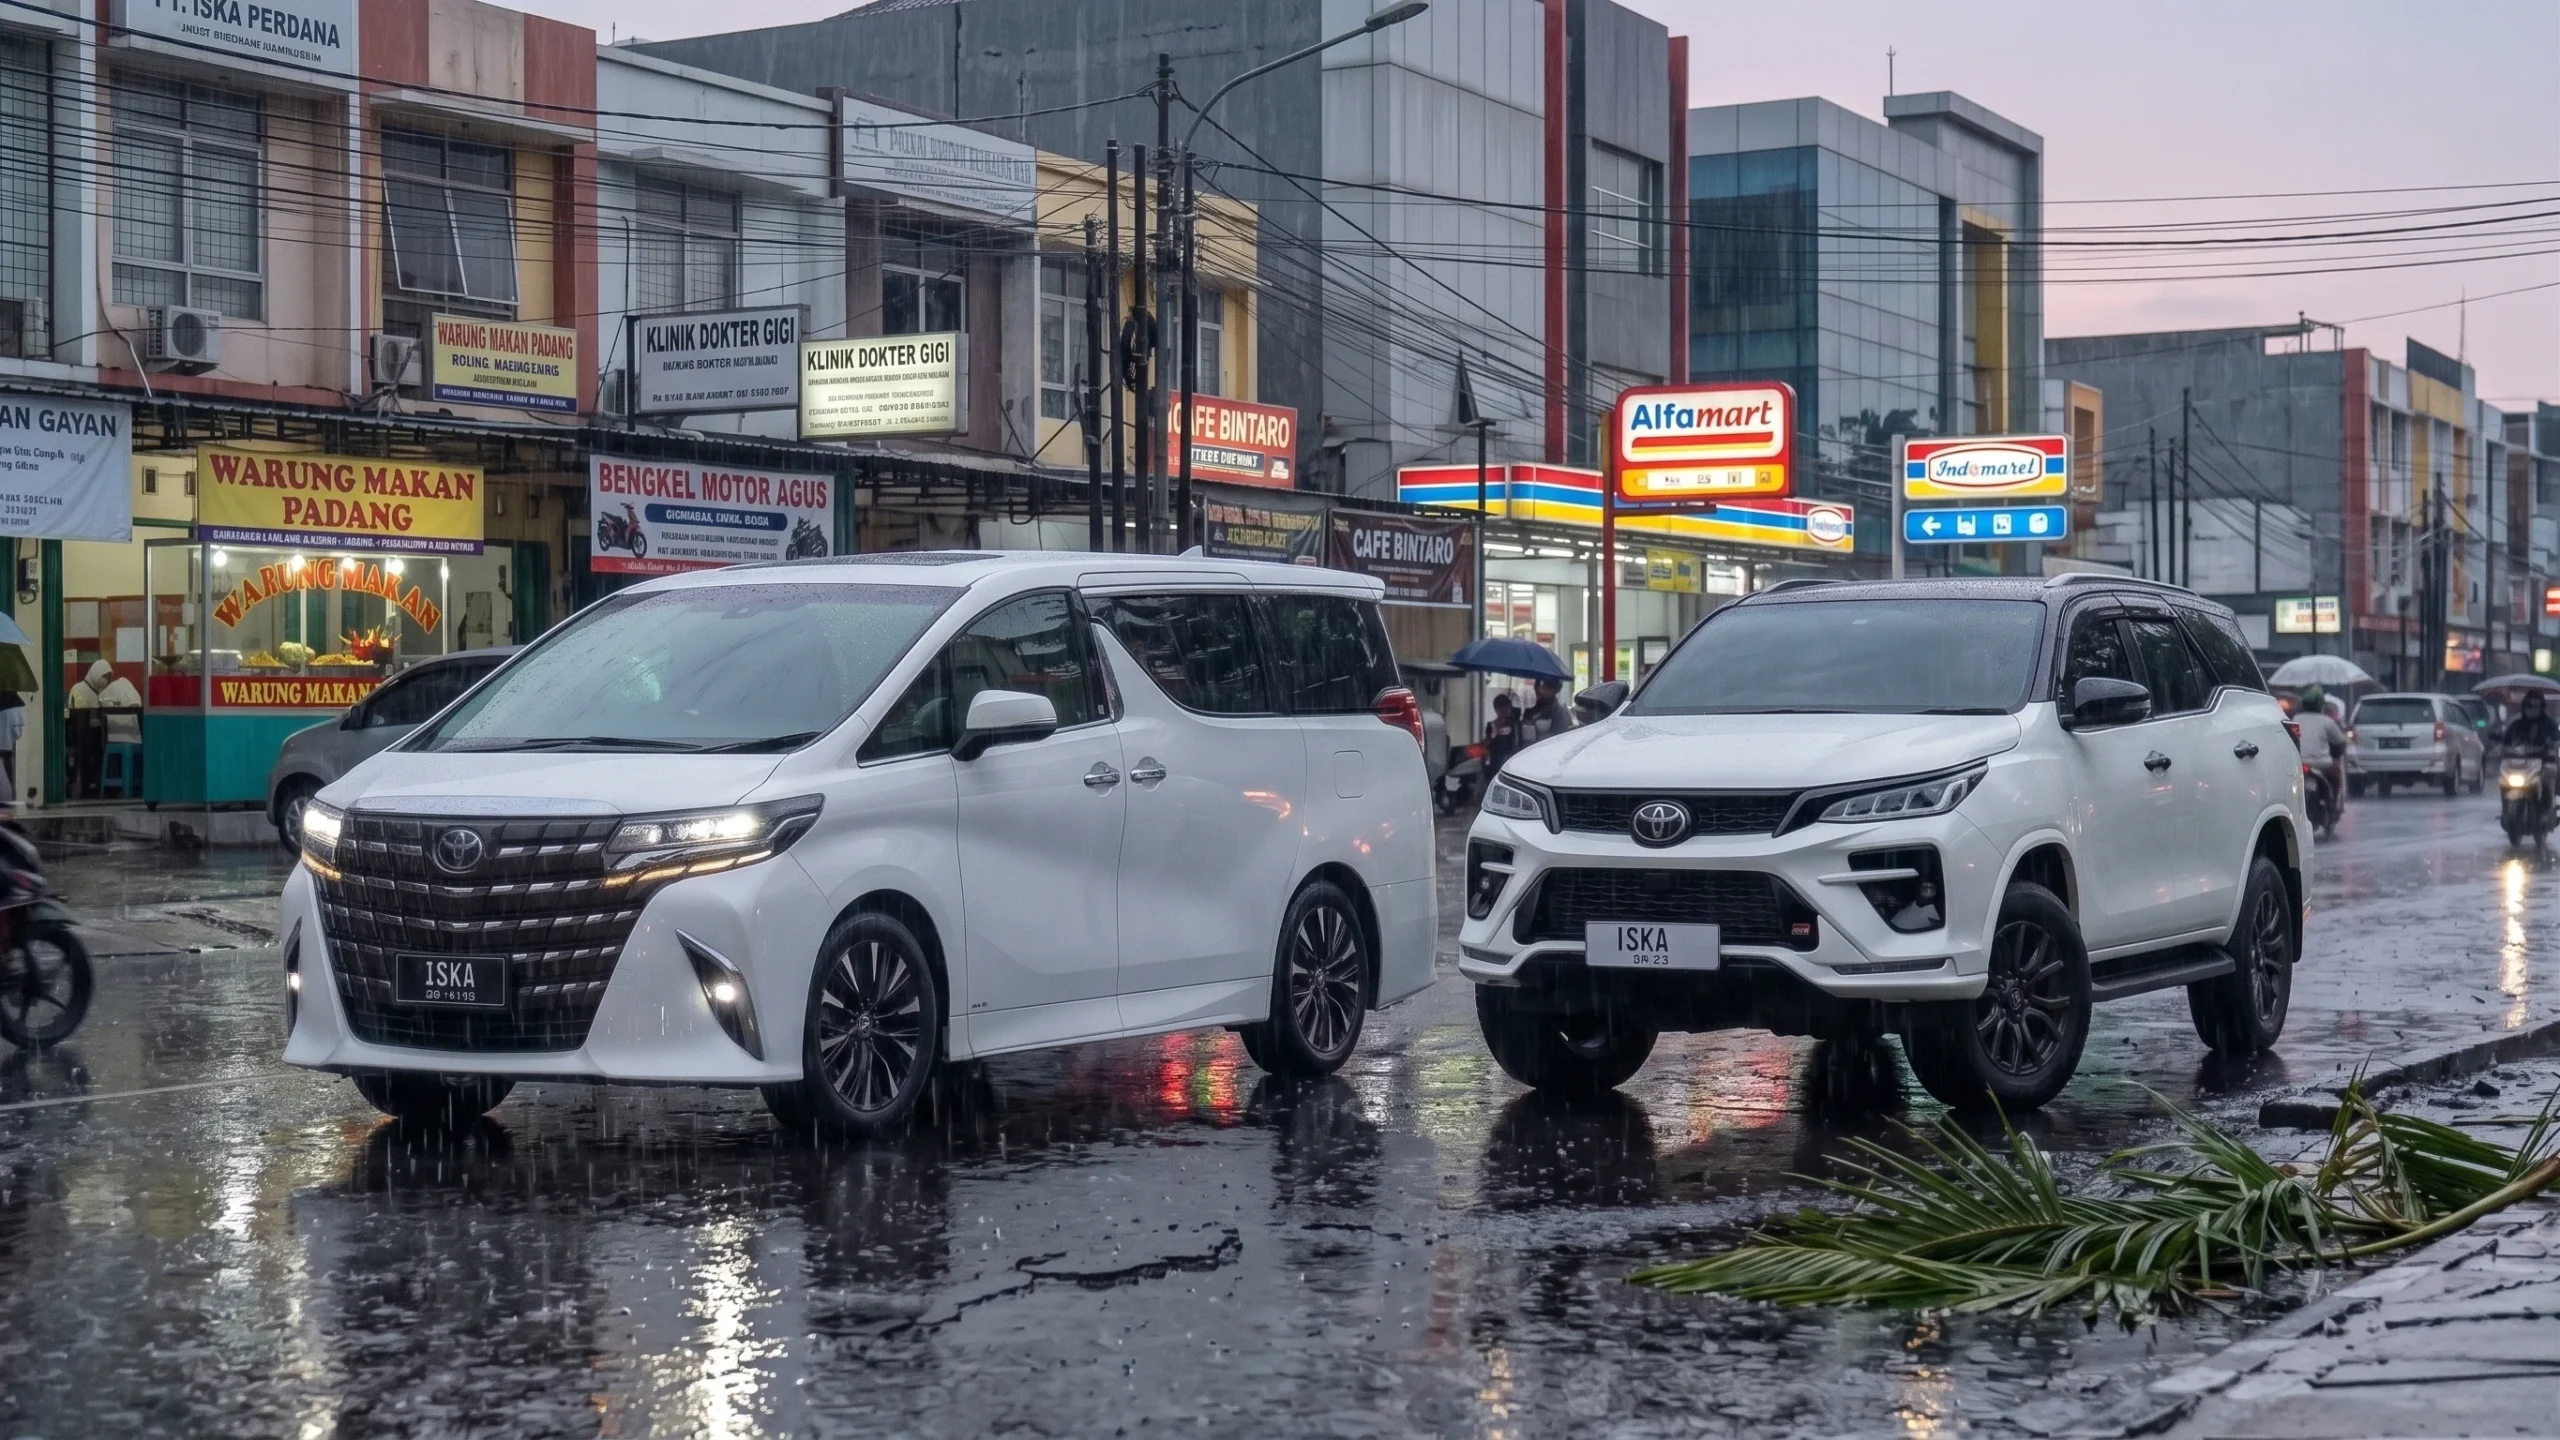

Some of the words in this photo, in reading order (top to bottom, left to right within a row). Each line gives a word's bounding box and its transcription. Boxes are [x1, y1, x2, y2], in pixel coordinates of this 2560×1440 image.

[193, 0, 242, 27] ISKA
[248, 4, 341, 48] PERDANA
[437, 321, 487, 349] WARUNG
[489, 327, 529, 355] MAKAN
[531, 332, 573, 360] PADANG
[646, 323, 696, 353] KLINIK
[699, 320, 760, 350] DOKTER
[763, 316, 795, 346] GIGI
[807, 348, 855, 371] KLINIK
[859, 344, 917, 368] DOKTER
[920, 341, 950, 364] GIGI
[38, 409, 117, 437] GAYAN
[1219, 408, 1290, 449] BINTARO
[1630, 400, 1773, 431] Alfamart
[209, 453, 356, 493] WARUNG
[363, 466, 475, 501] MAKAN
[599, 462, 696, 500] BENGKEL
[702, 471, 771, 506] MOTOR
[776, 478, 828, 510] AGUS
[282, 496, 413, 531] PADANG
[1353, 528, 1391, 560] CAFE
[1393, 532, 1454, 565] BINTARO
[212, 558, 336, 629] WARUNG
[340, 560, 441, 635] MAKAN
[220, 681, 302, 704] WARUNG
[305, 682, 370, 704] MAKAN
[1618, 926, 1669, 952] ISKA
[425, 961, 475, 988] ISKA
[1653, 955, 1669, 965] 23
